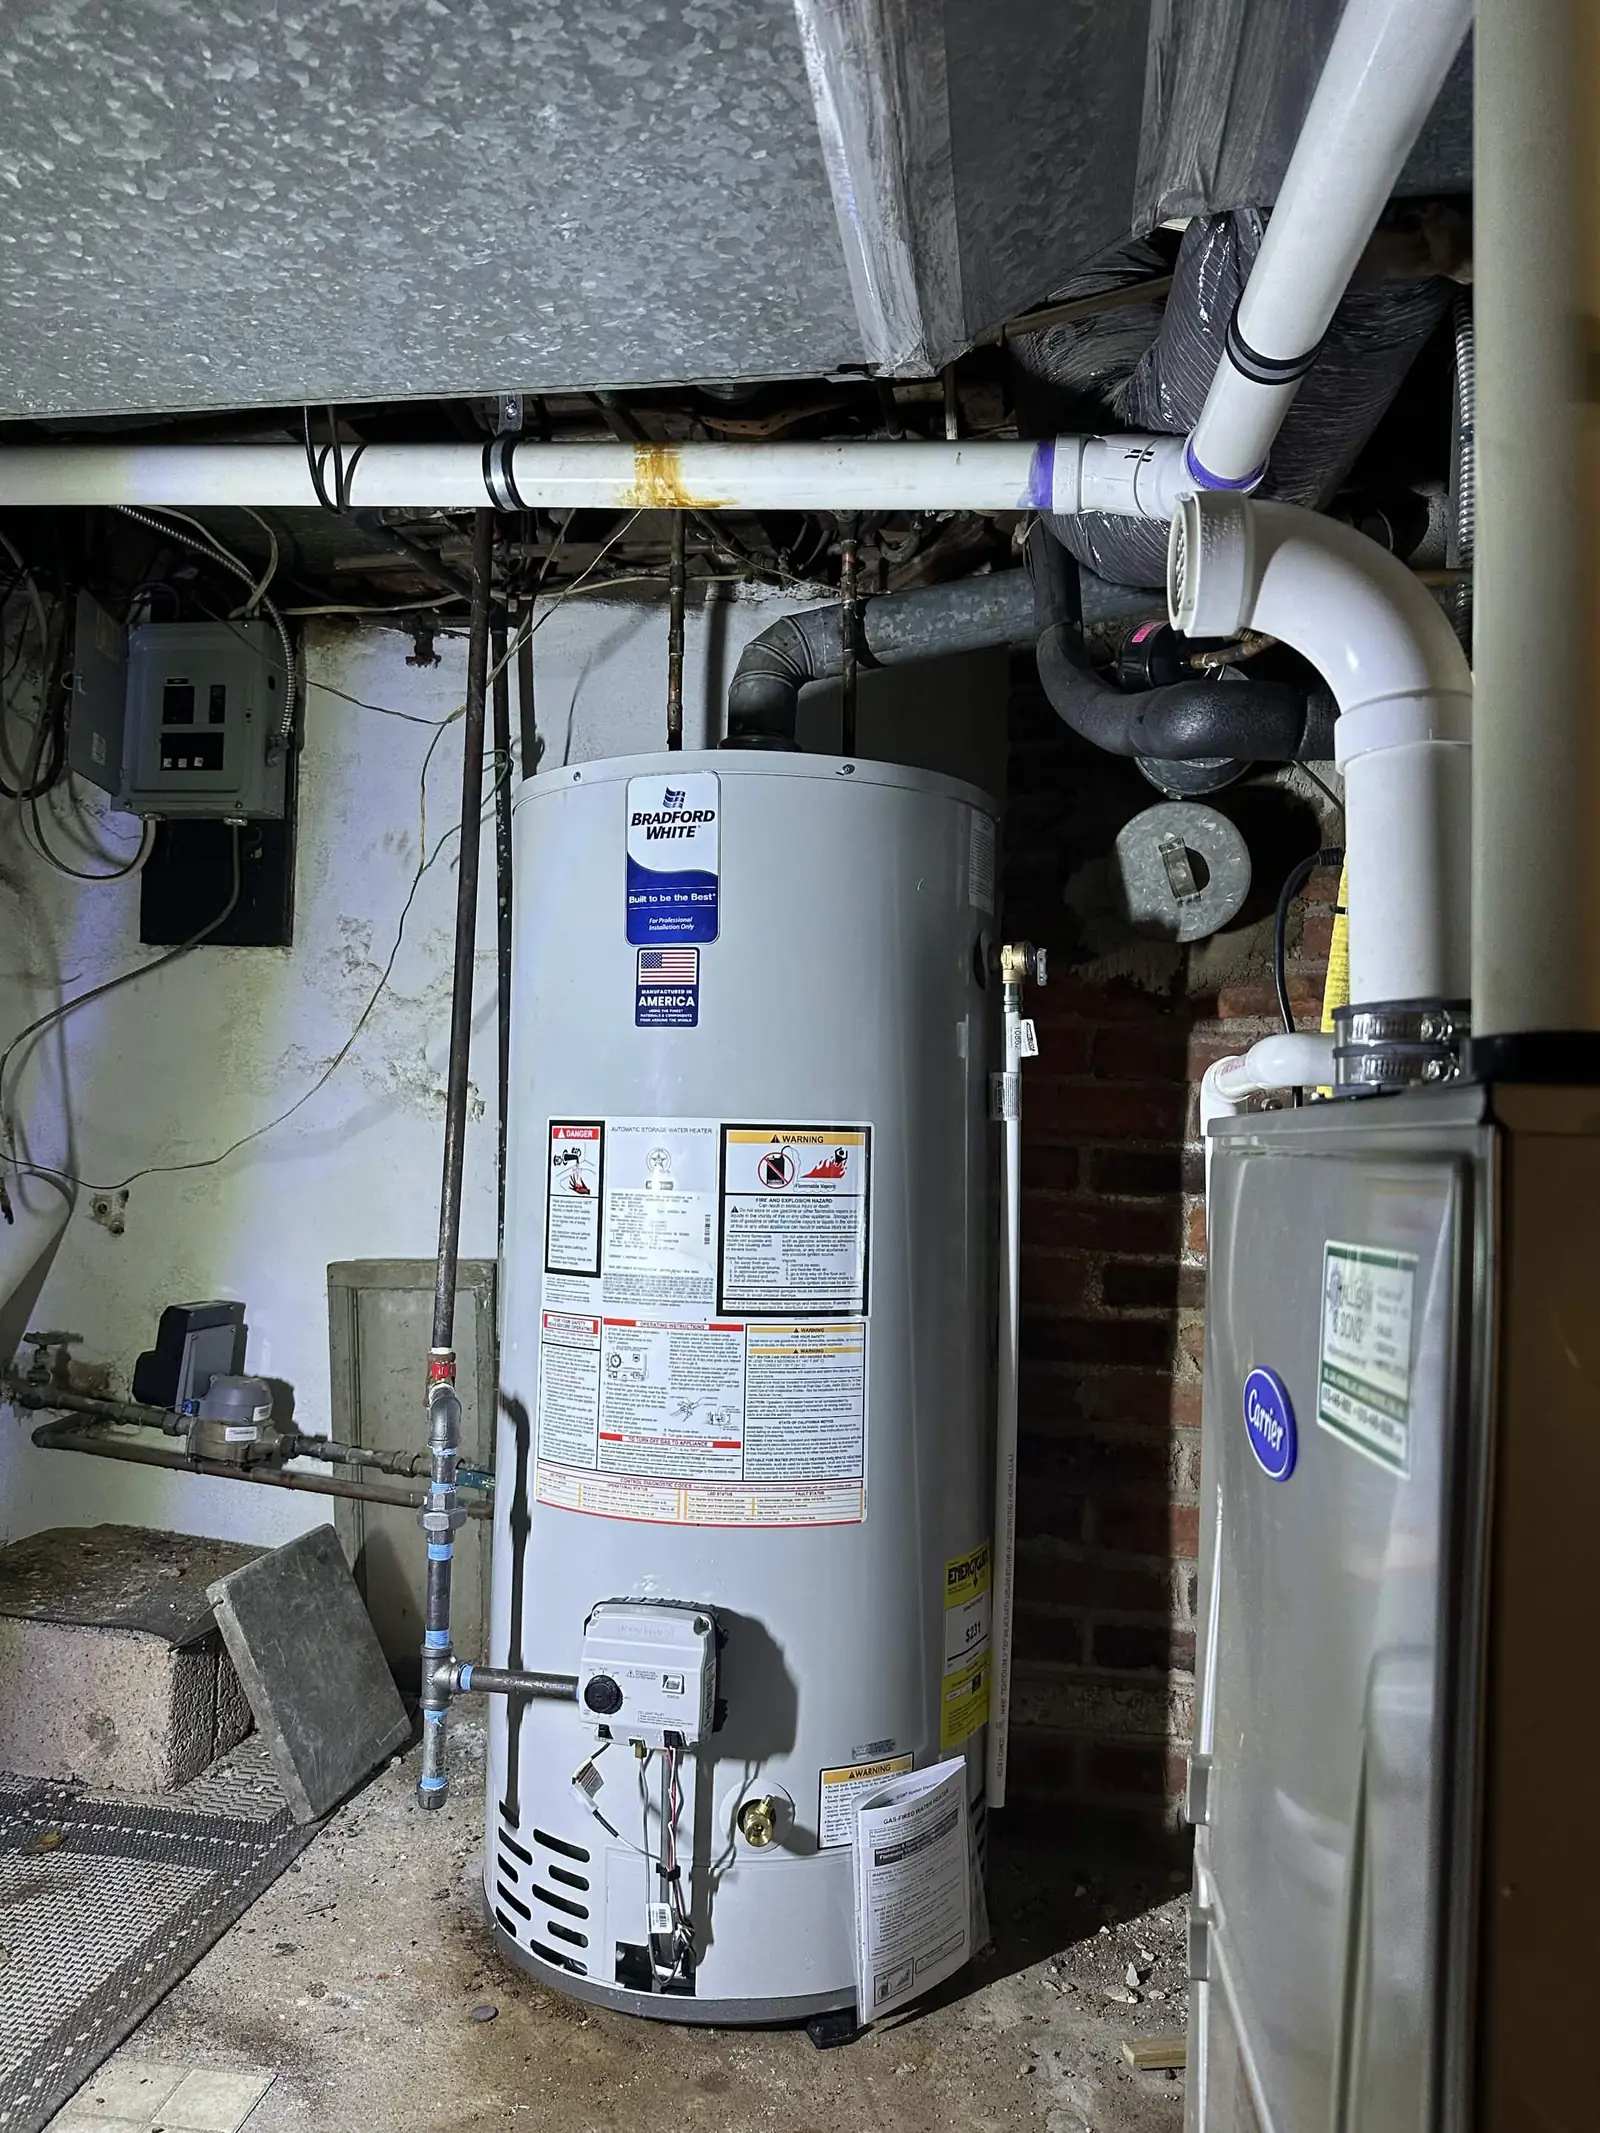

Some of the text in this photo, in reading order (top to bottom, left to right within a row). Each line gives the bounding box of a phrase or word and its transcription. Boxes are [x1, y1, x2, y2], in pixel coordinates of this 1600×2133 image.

[631, 810, 715, 826] BRADFORD
[646, 825, 697, 840] WHITE
[628, 895, 647, 904] Built
[660, 893, 671, 902] be
[673, 893, 688, 901] the
[691, 893, 712, 901] Best
[658, 916, 693, 924] Professional
[680, 923, 694, 931] Only
[638, 996, 695, 1007] AMERICA
[566, 1130, 593, 1138] DANGER
[782, 1136, 824, 1144] WARNING
[1248, 1388, 1284, 1452] Carrier
[643, 1480, 673, 1488] DIAGNOSTIC
[965, 1620, 981, 1643] $231
[855, 1764, 891, 1778] WARNING
[883, 1788, 949, 1825] GAS-FIRED WATER HEATER
